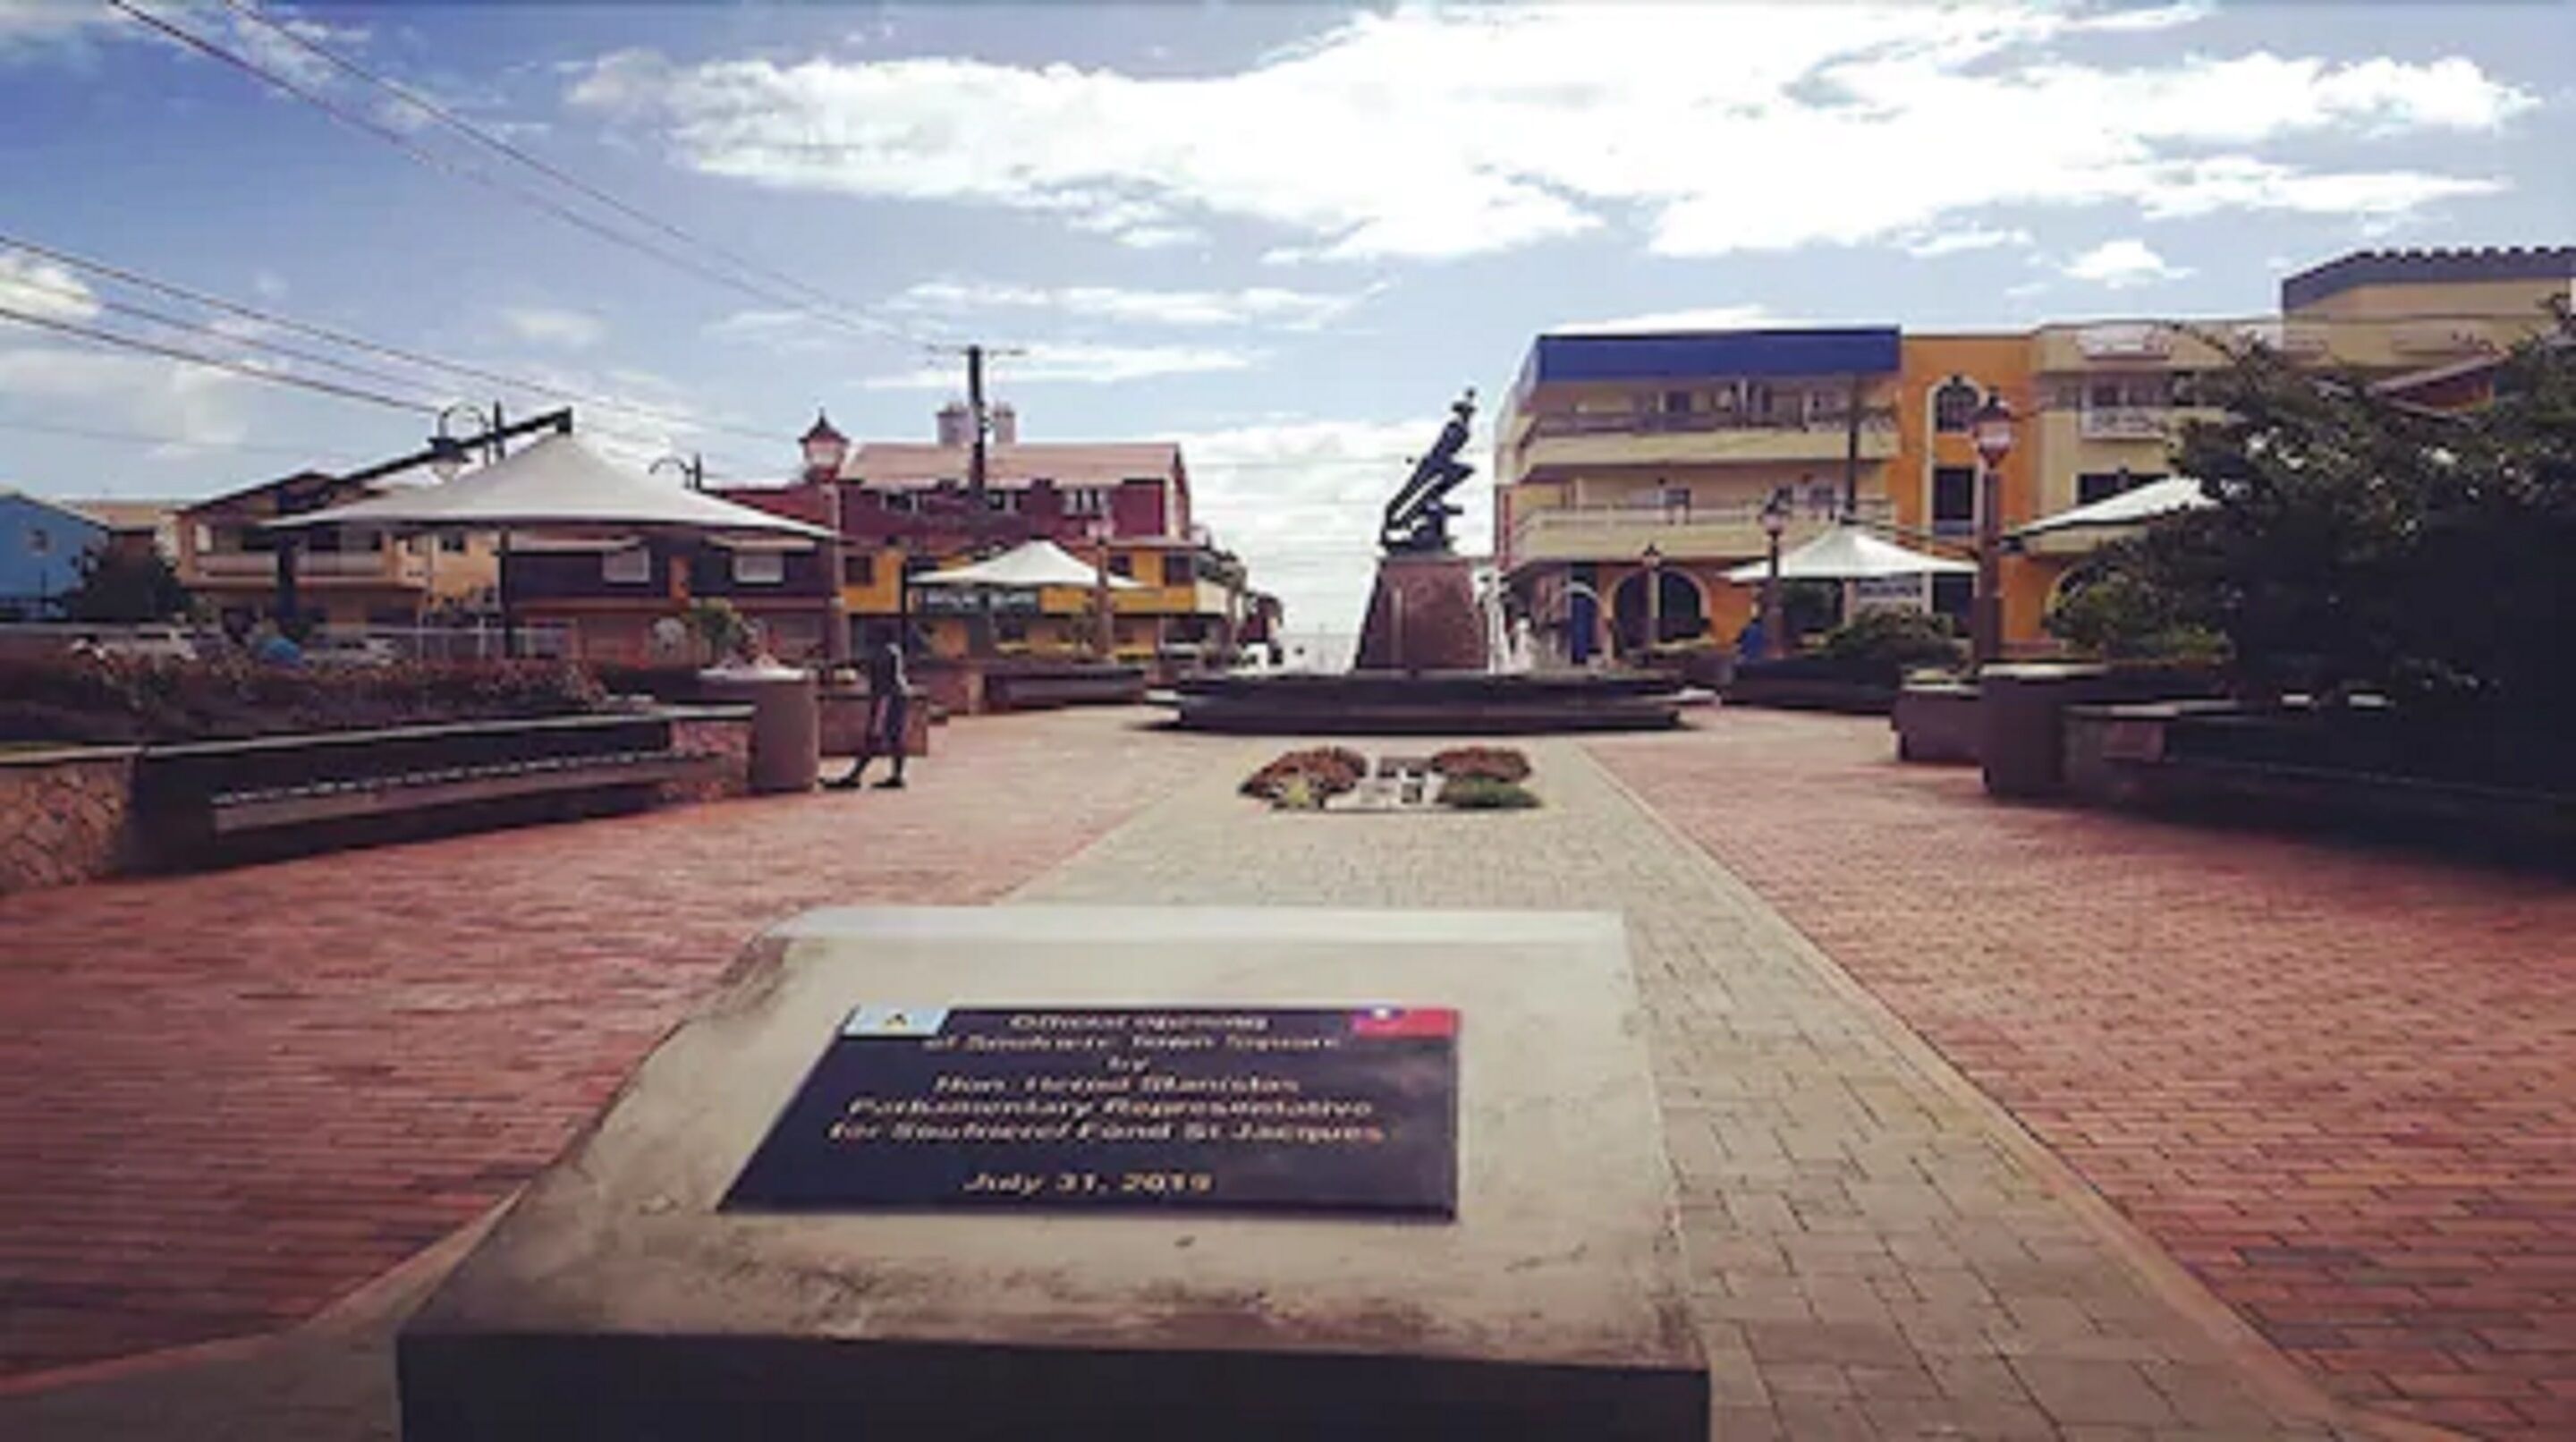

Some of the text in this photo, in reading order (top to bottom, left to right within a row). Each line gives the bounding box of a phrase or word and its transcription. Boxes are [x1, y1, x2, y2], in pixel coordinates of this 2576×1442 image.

[1107, 1055, 1150, 1073] by
[1103, 1099, 1374, 1118] Representative
[828, 1122, 881, 1140] for
[1230, 1122, 1385, 1144] Jacques
[963, 1173, 1045, 1195] July
[1121, 1173, 1214, 1192] 2019
